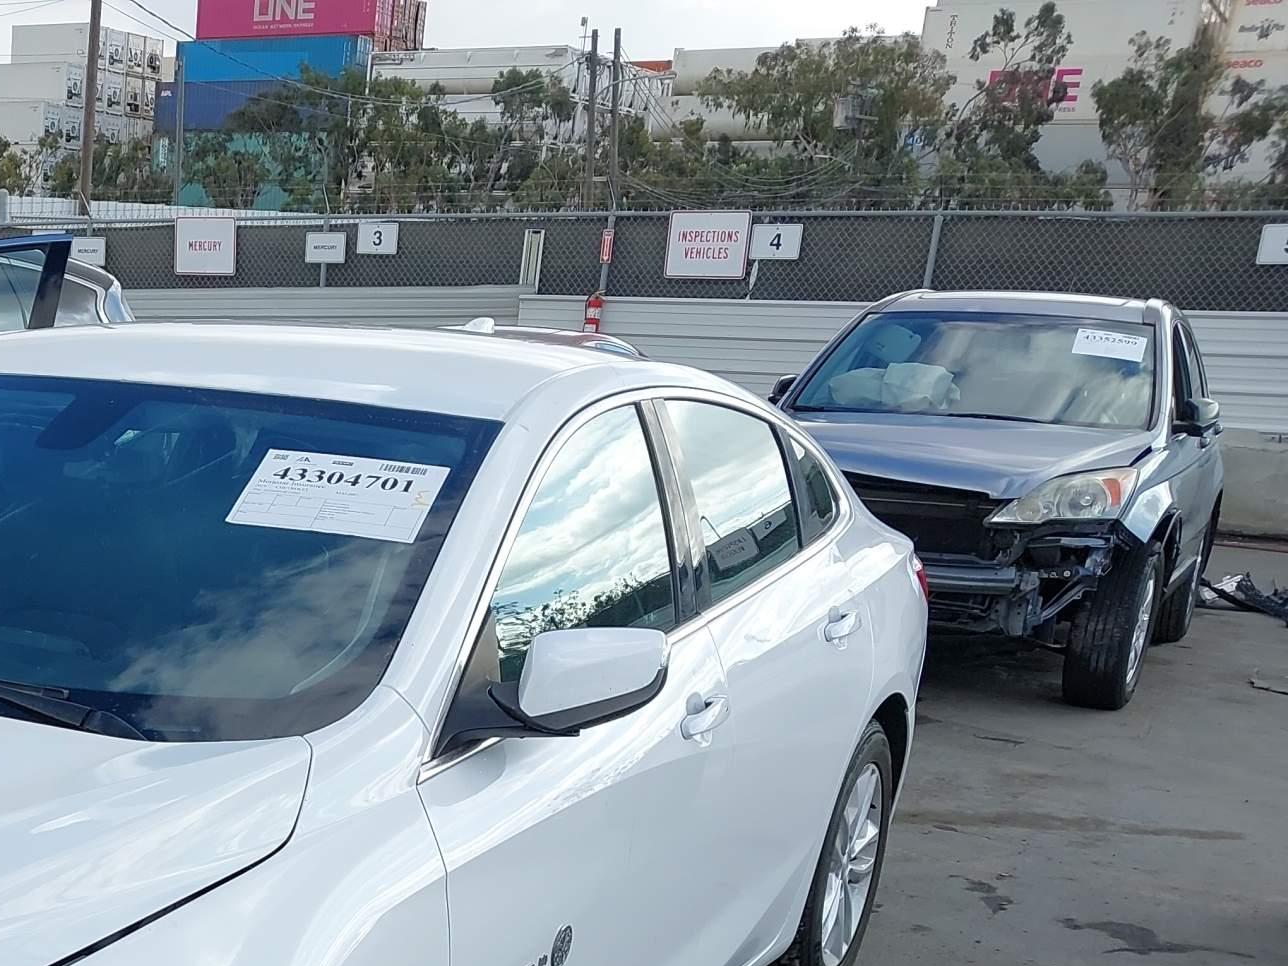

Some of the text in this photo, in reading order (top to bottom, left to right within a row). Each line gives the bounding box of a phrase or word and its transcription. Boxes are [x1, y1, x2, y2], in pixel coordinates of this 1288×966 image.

[945, 14, 958, 49] TRITON
[372, 230, 382, 246] 3
[678, 230, 740, 243] INSPECTIONS
[769, 233, 782, 250] 4
[188, 240, 223, 252] MERCURY
[684, 247, 729, 260] VEHICLES
[273, 465, 415, 493] 43304701
